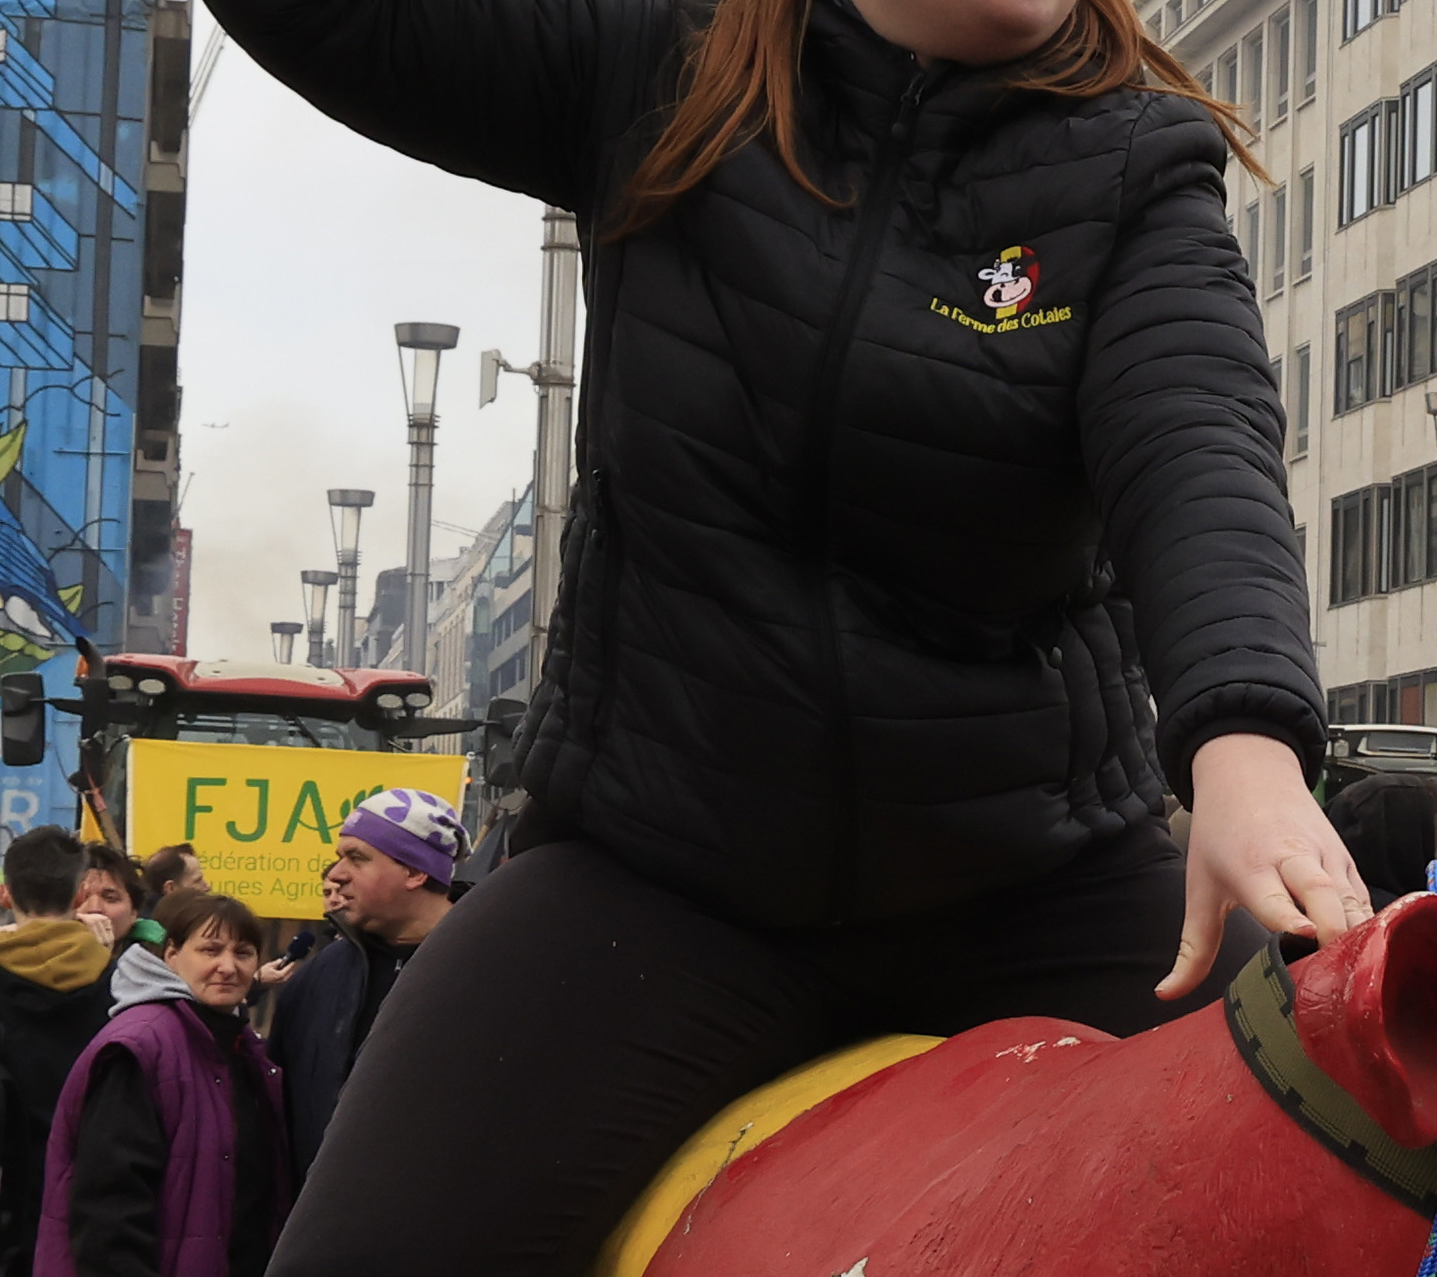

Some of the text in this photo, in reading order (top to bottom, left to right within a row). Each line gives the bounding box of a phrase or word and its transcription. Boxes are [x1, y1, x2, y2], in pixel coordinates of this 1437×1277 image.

[930, 297, 949, 316] La
[951, 307, 996, 334] Ferme
[997, 319, 1019, 333] des
[185, 777, 333, 845] FJA
[199, 853, 301, 873] édération
